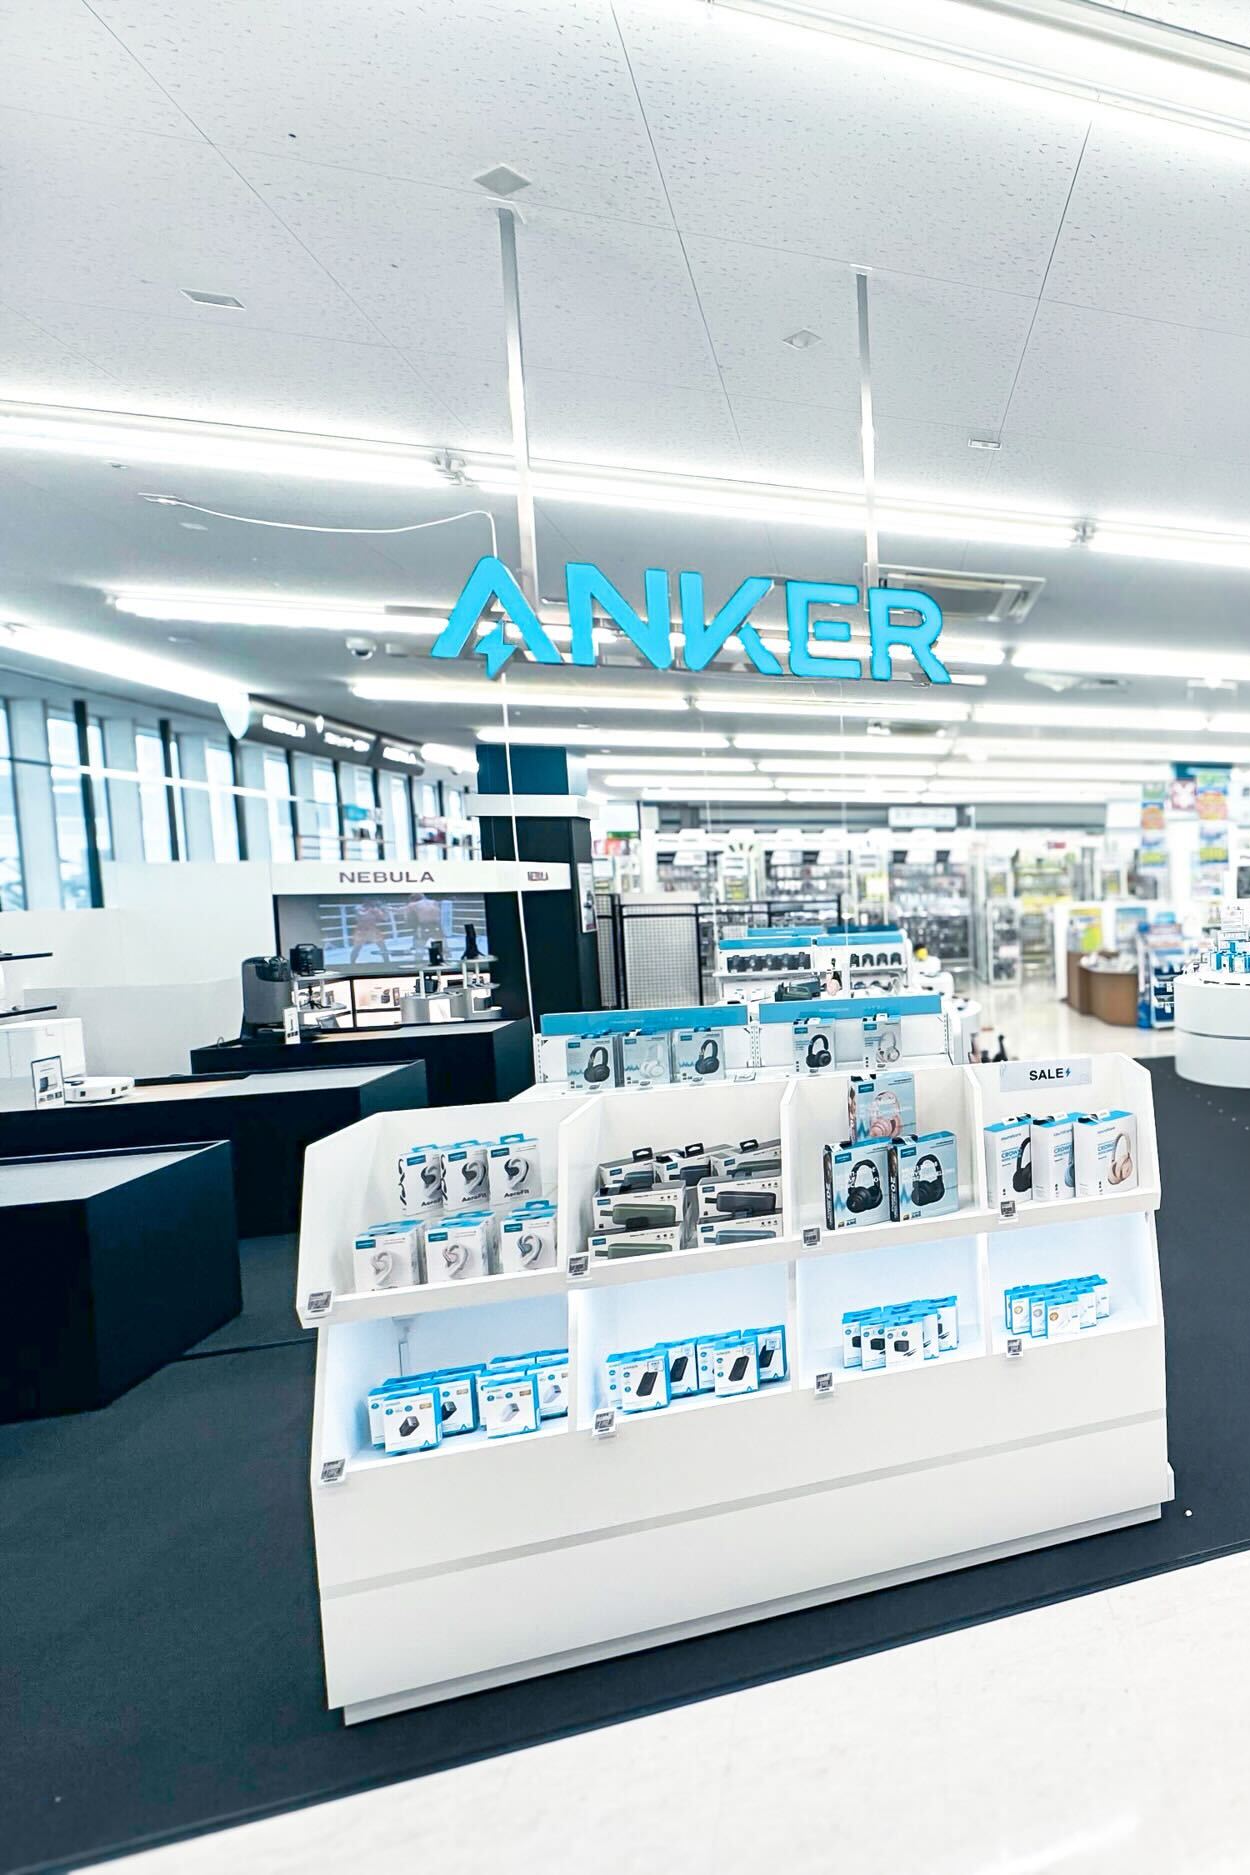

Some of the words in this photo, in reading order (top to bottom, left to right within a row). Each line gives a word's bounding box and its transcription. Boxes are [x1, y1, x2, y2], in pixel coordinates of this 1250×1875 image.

[431, 555, 951, 684] ANKER
[339, 871, 435, 883] NEBULA
[1029, 1068, 1064, 1081] SALE
